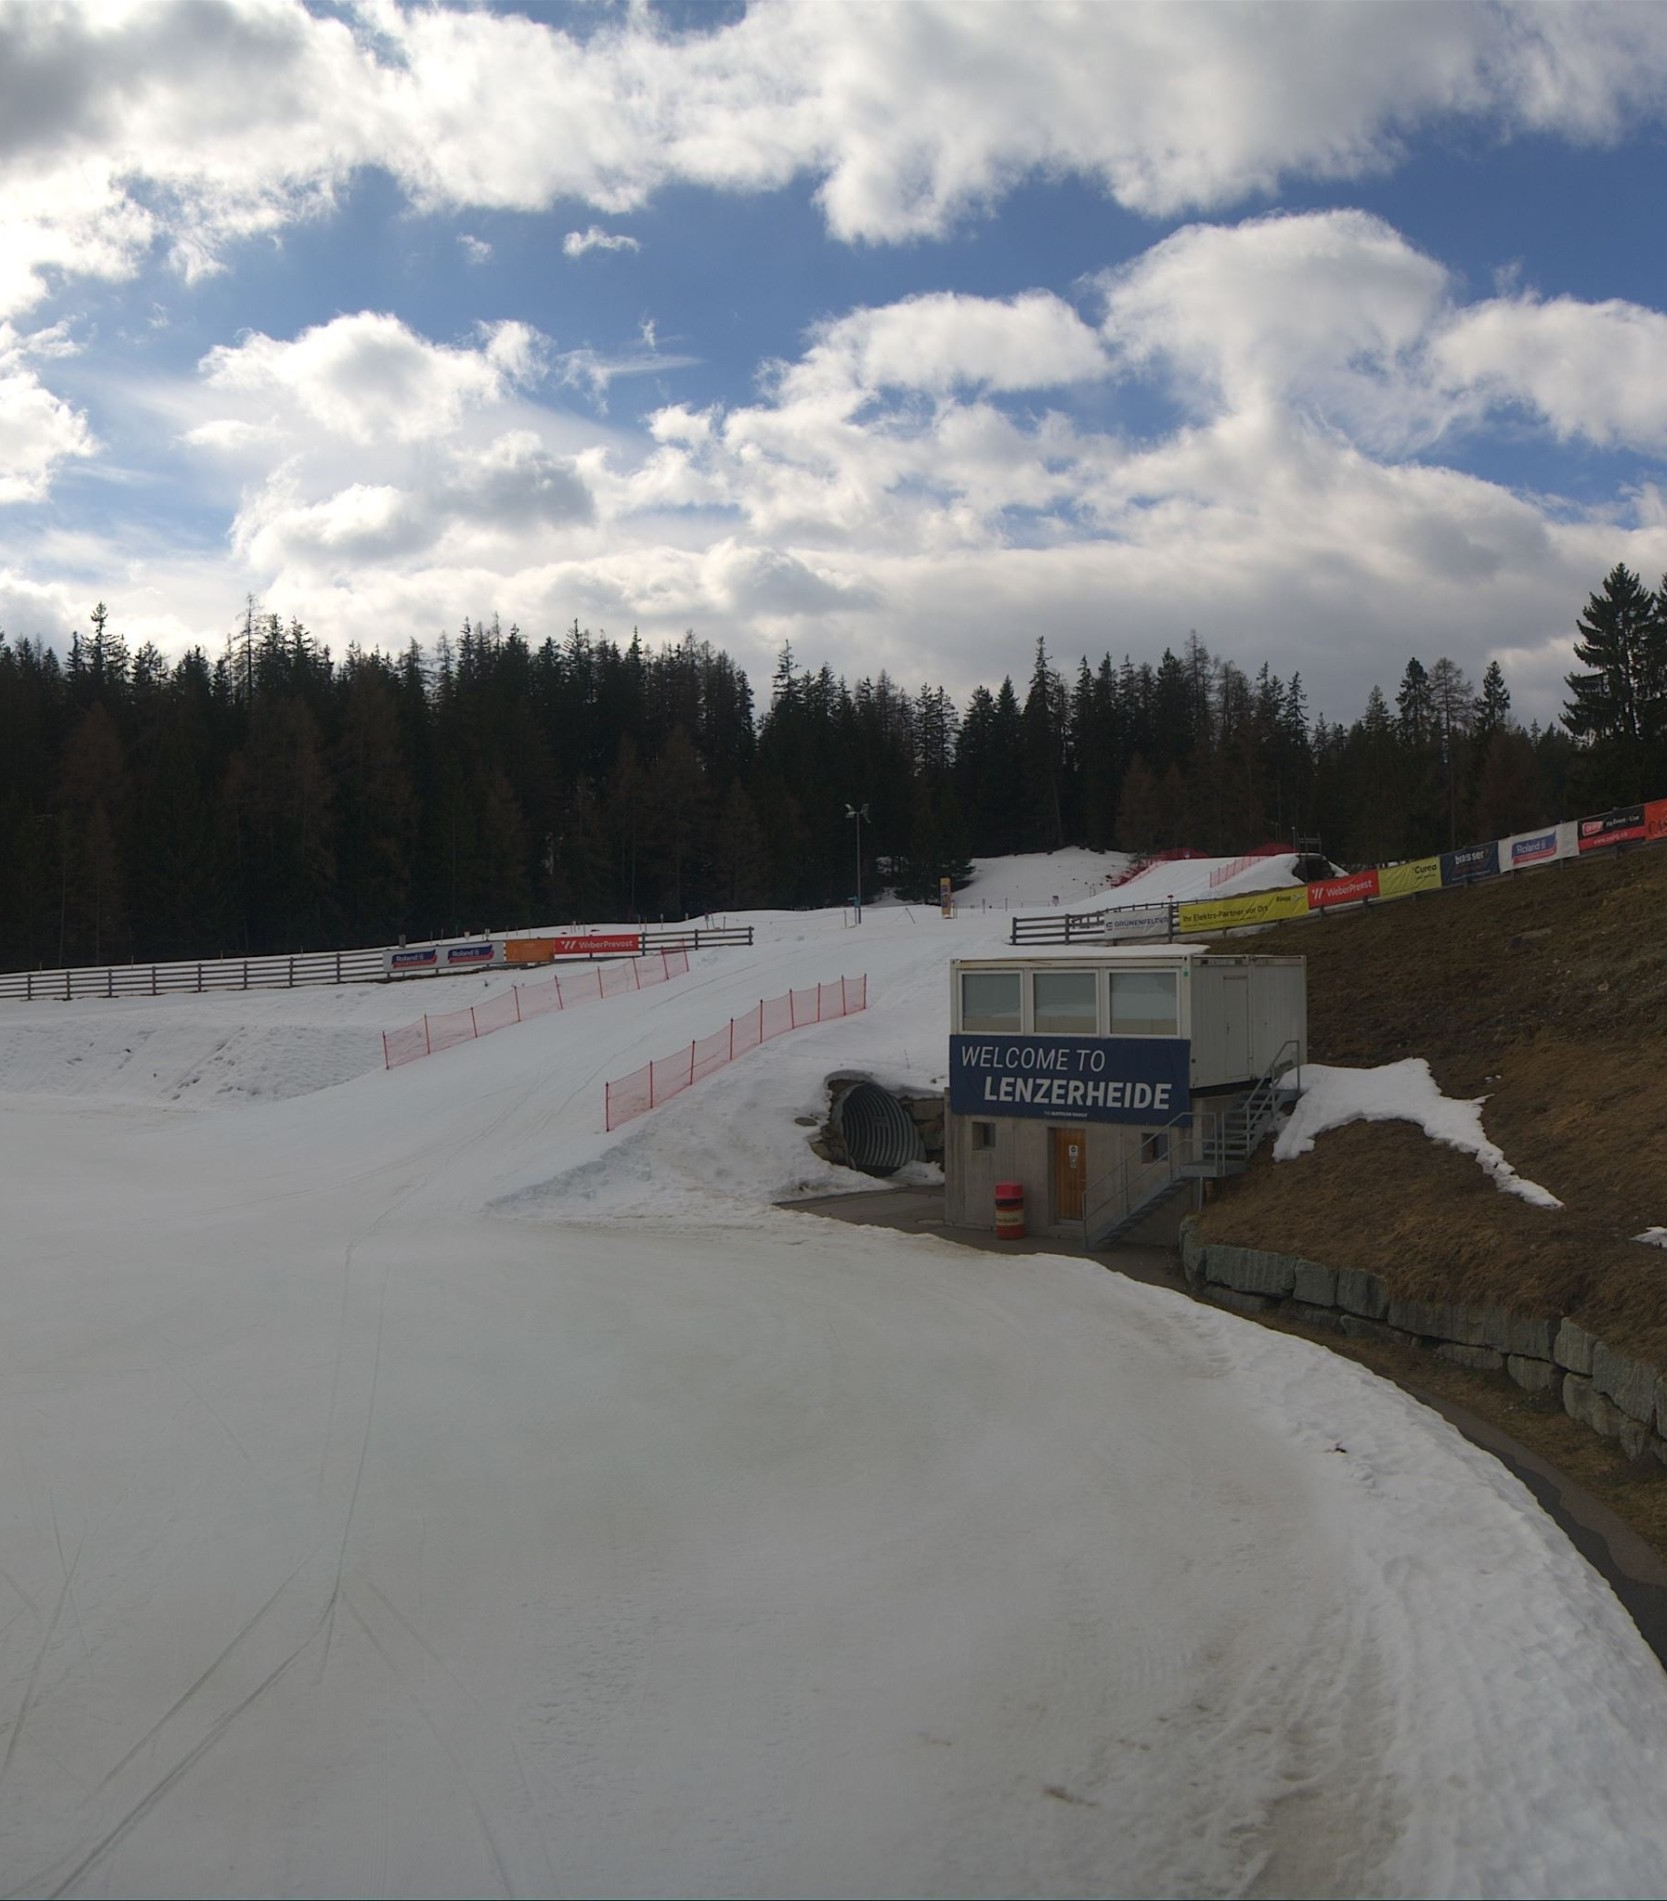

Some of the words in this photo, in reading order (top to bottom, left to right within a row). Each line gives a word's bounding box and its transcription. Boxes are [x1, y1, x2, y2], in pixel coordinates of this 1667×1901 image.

[1516, 842, 1541, 854] Roland
[1194, 908, 1244, 922] Elektro-Partner
[962, 1046, 1070, 1071] WELCOME
[1076, 1048, 1106, 1072] TO
[984, 1076, 1172, 1110] LENZERHEIDE
